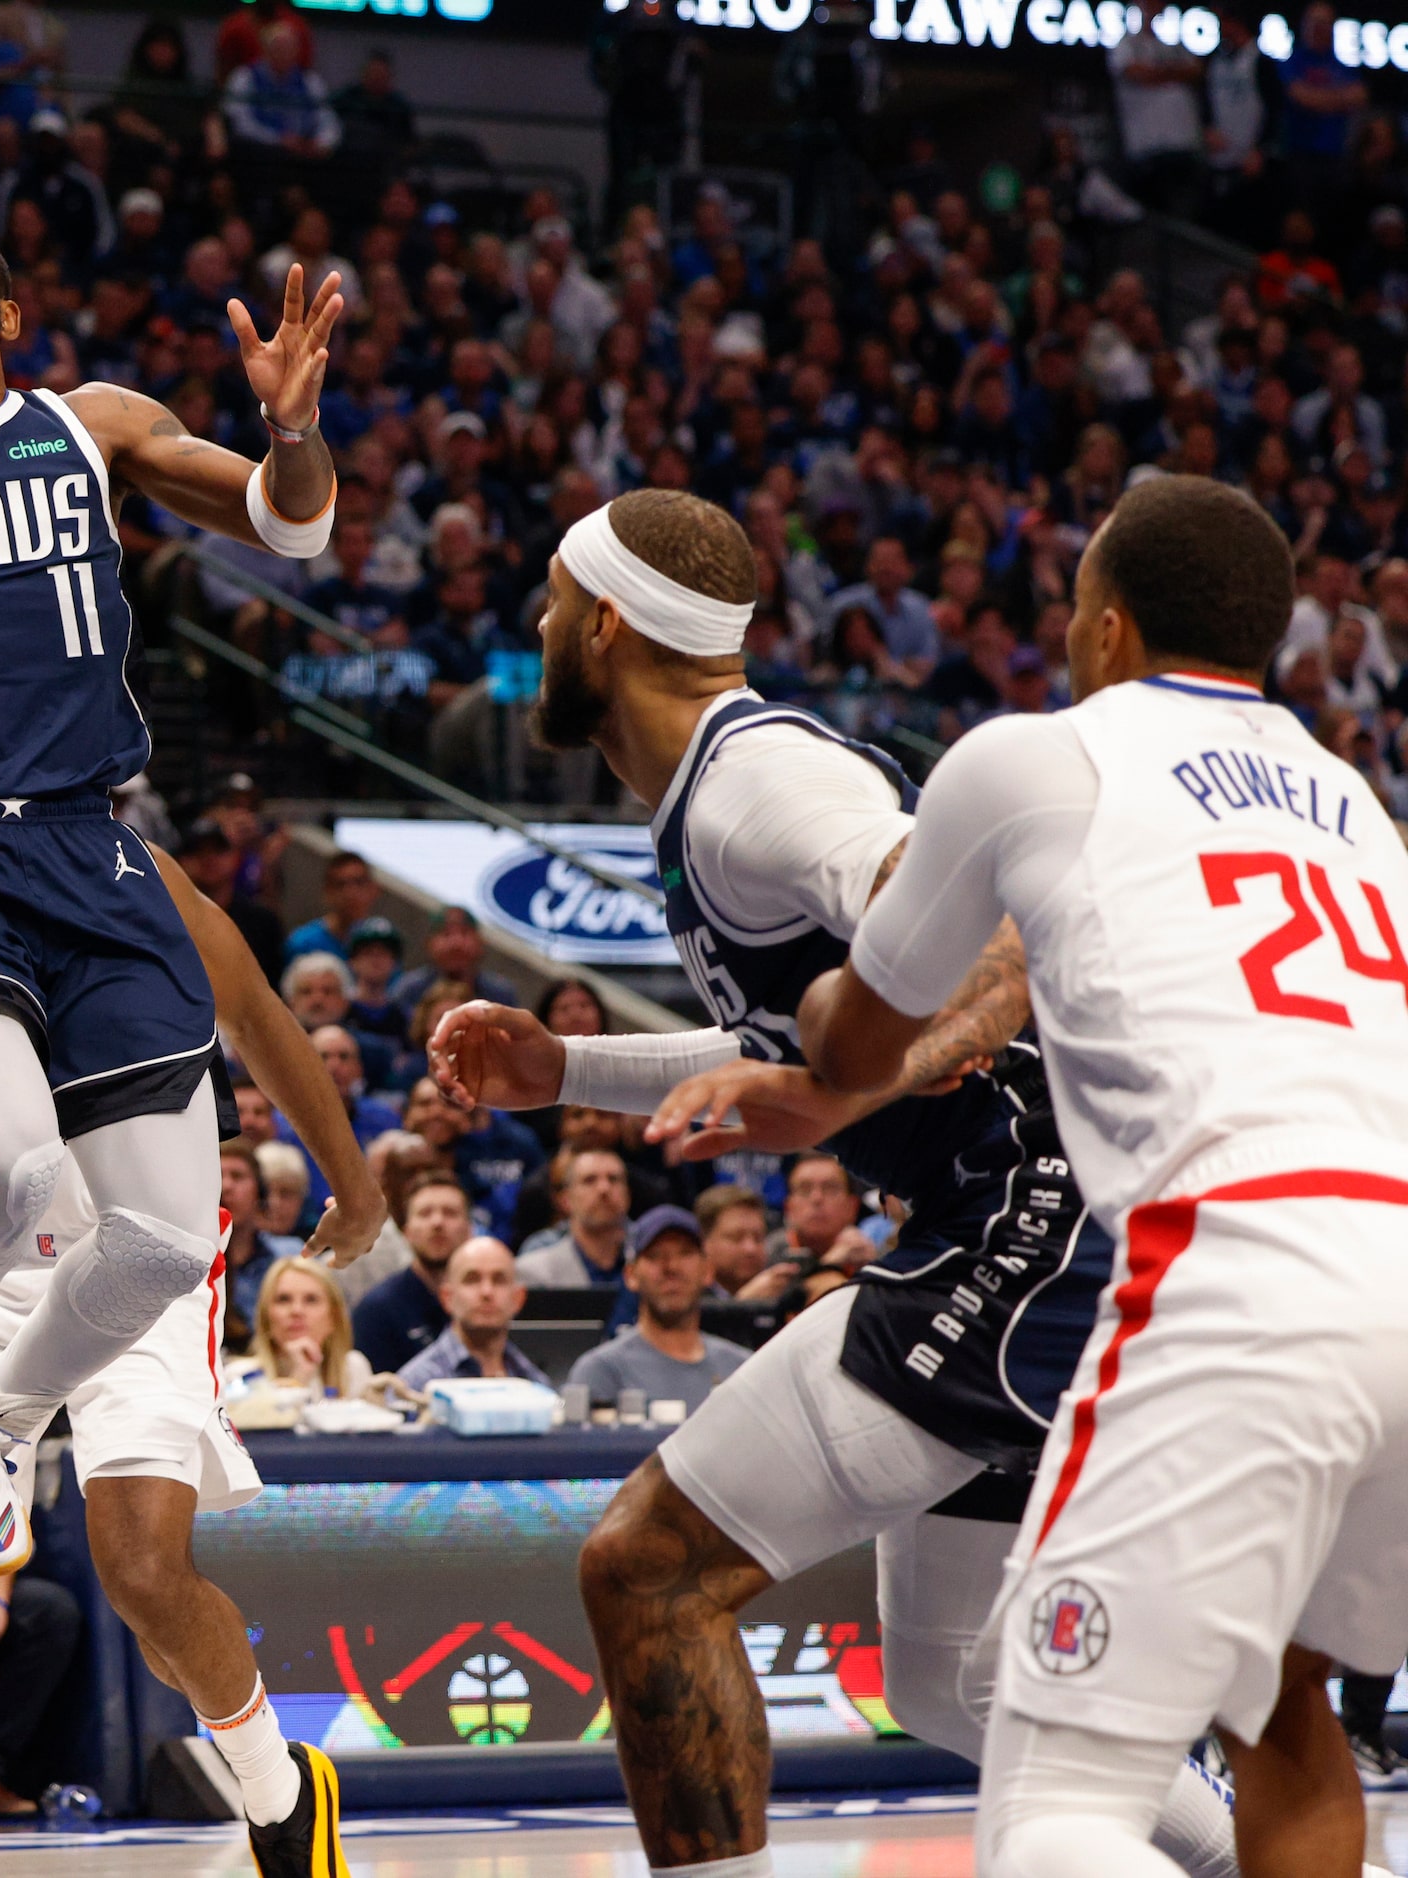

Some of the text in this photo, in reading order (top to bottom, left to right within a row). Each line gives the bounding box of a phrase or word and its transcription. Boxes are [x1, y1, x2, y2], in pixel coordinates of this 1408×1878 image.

[8, 438, 68, 461] chime
[47, 562, 105, 658] 11
[1171, 749, 1355, 847] POWELL
[1198, 852, 1408, 1030] 24
